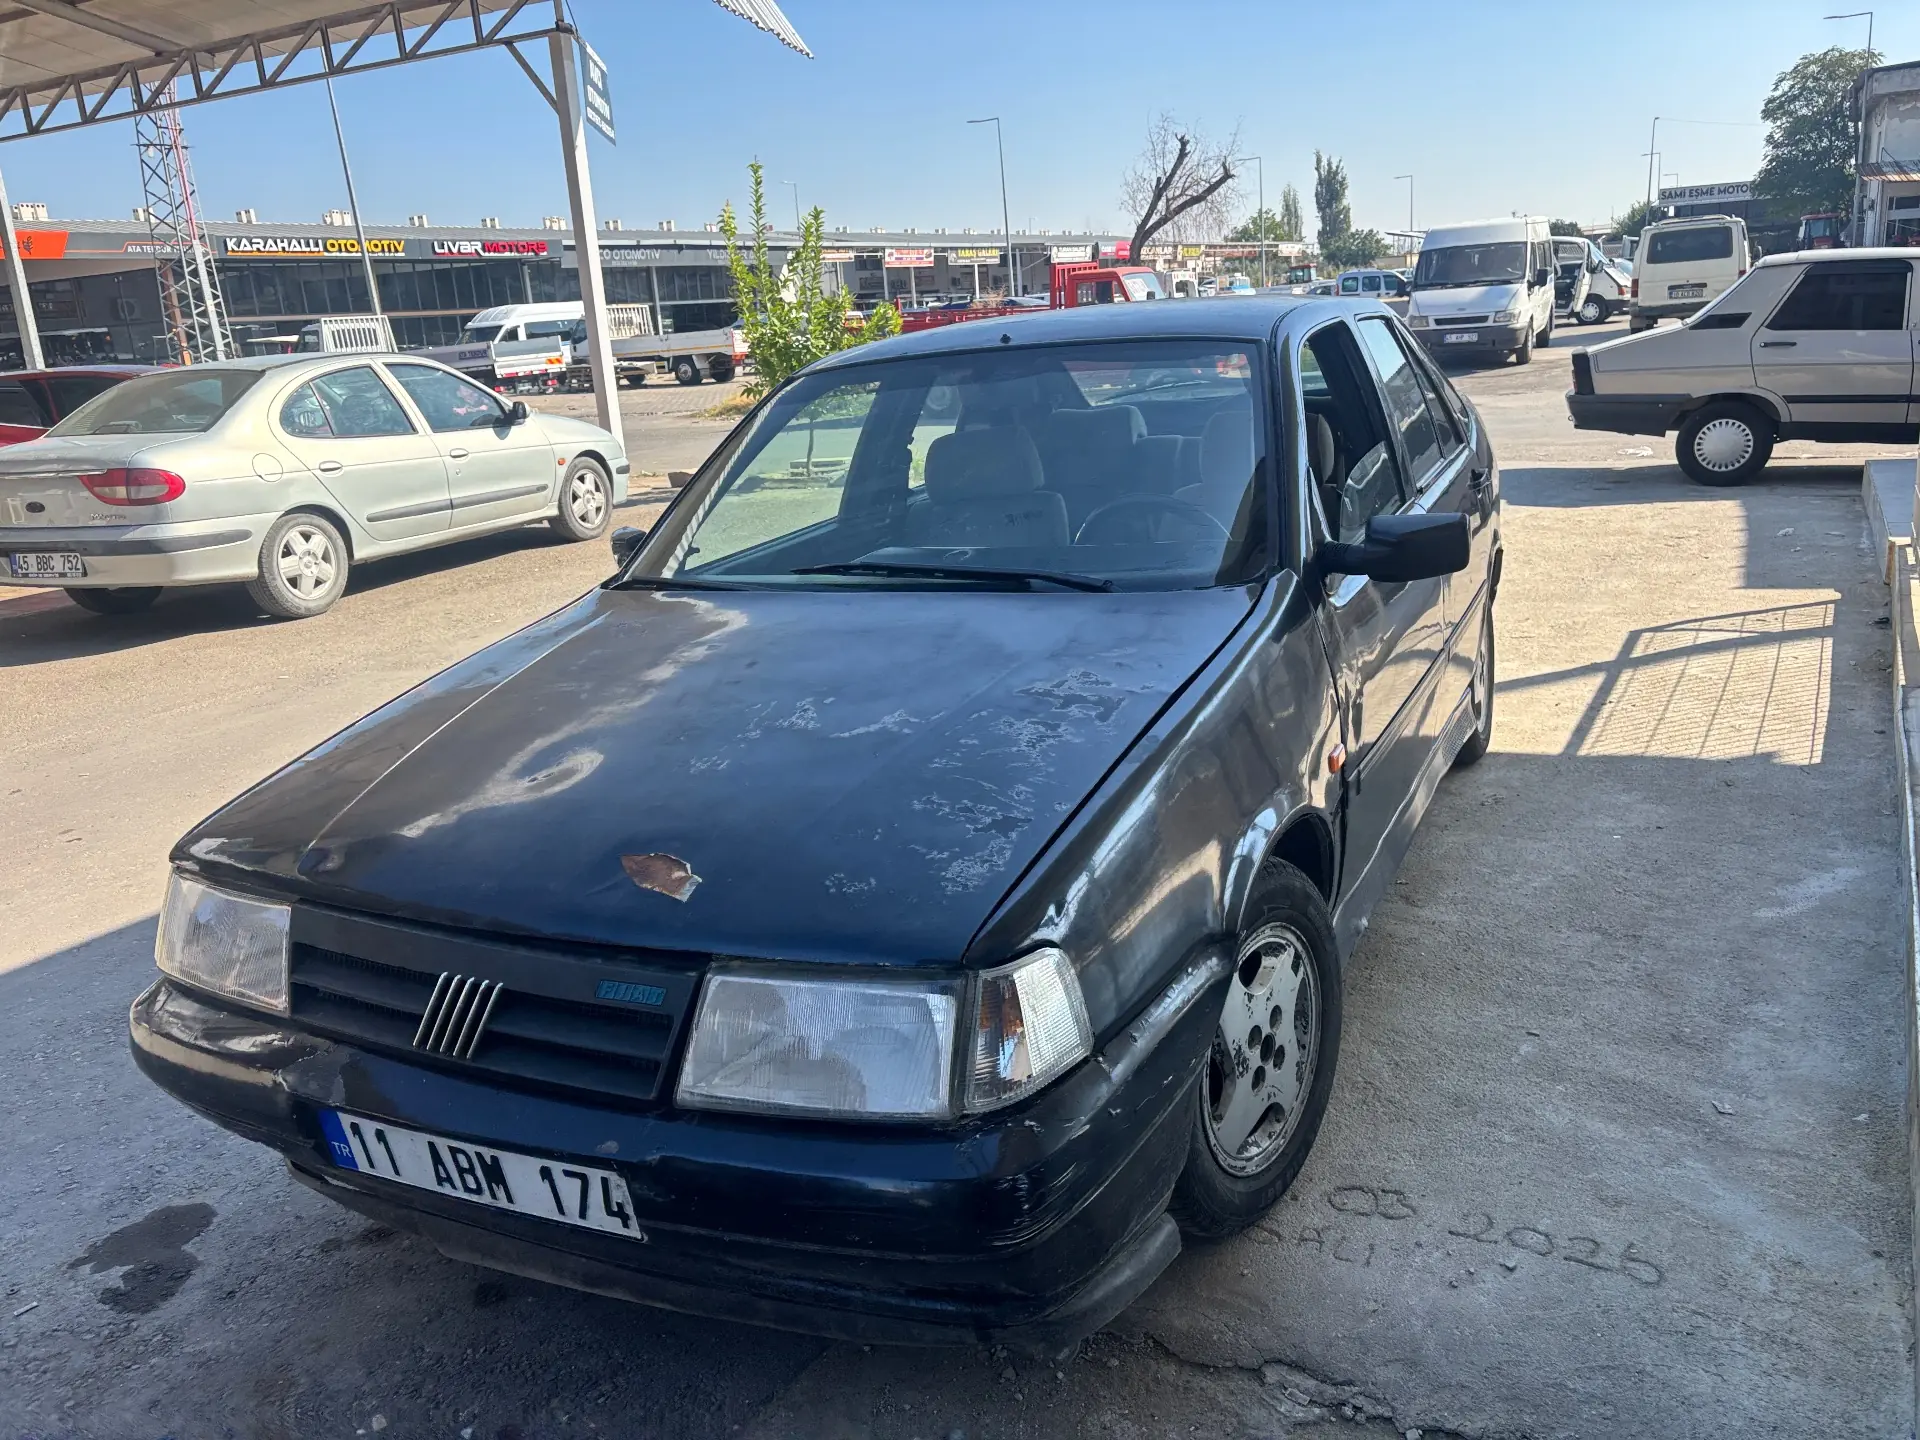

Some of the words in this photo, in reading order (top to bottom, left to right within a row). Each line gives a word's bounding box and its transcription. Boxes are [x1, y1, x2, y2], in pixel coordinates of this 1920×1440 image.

[1688, 186, 1715, 200] EŞME
[225, 238, 324, 252] KARAHALLI
[17, 555, 29, 571] 45
[35, 555, 55, 571] BBC
[60, 555, 81, 571] 752
[332, 1141, 354, 1158] TR
[349, 1121, 400, 1177] 11
[427, 1140, 516, 1204] ABM
[538, 1164, 630, 1229] 174
